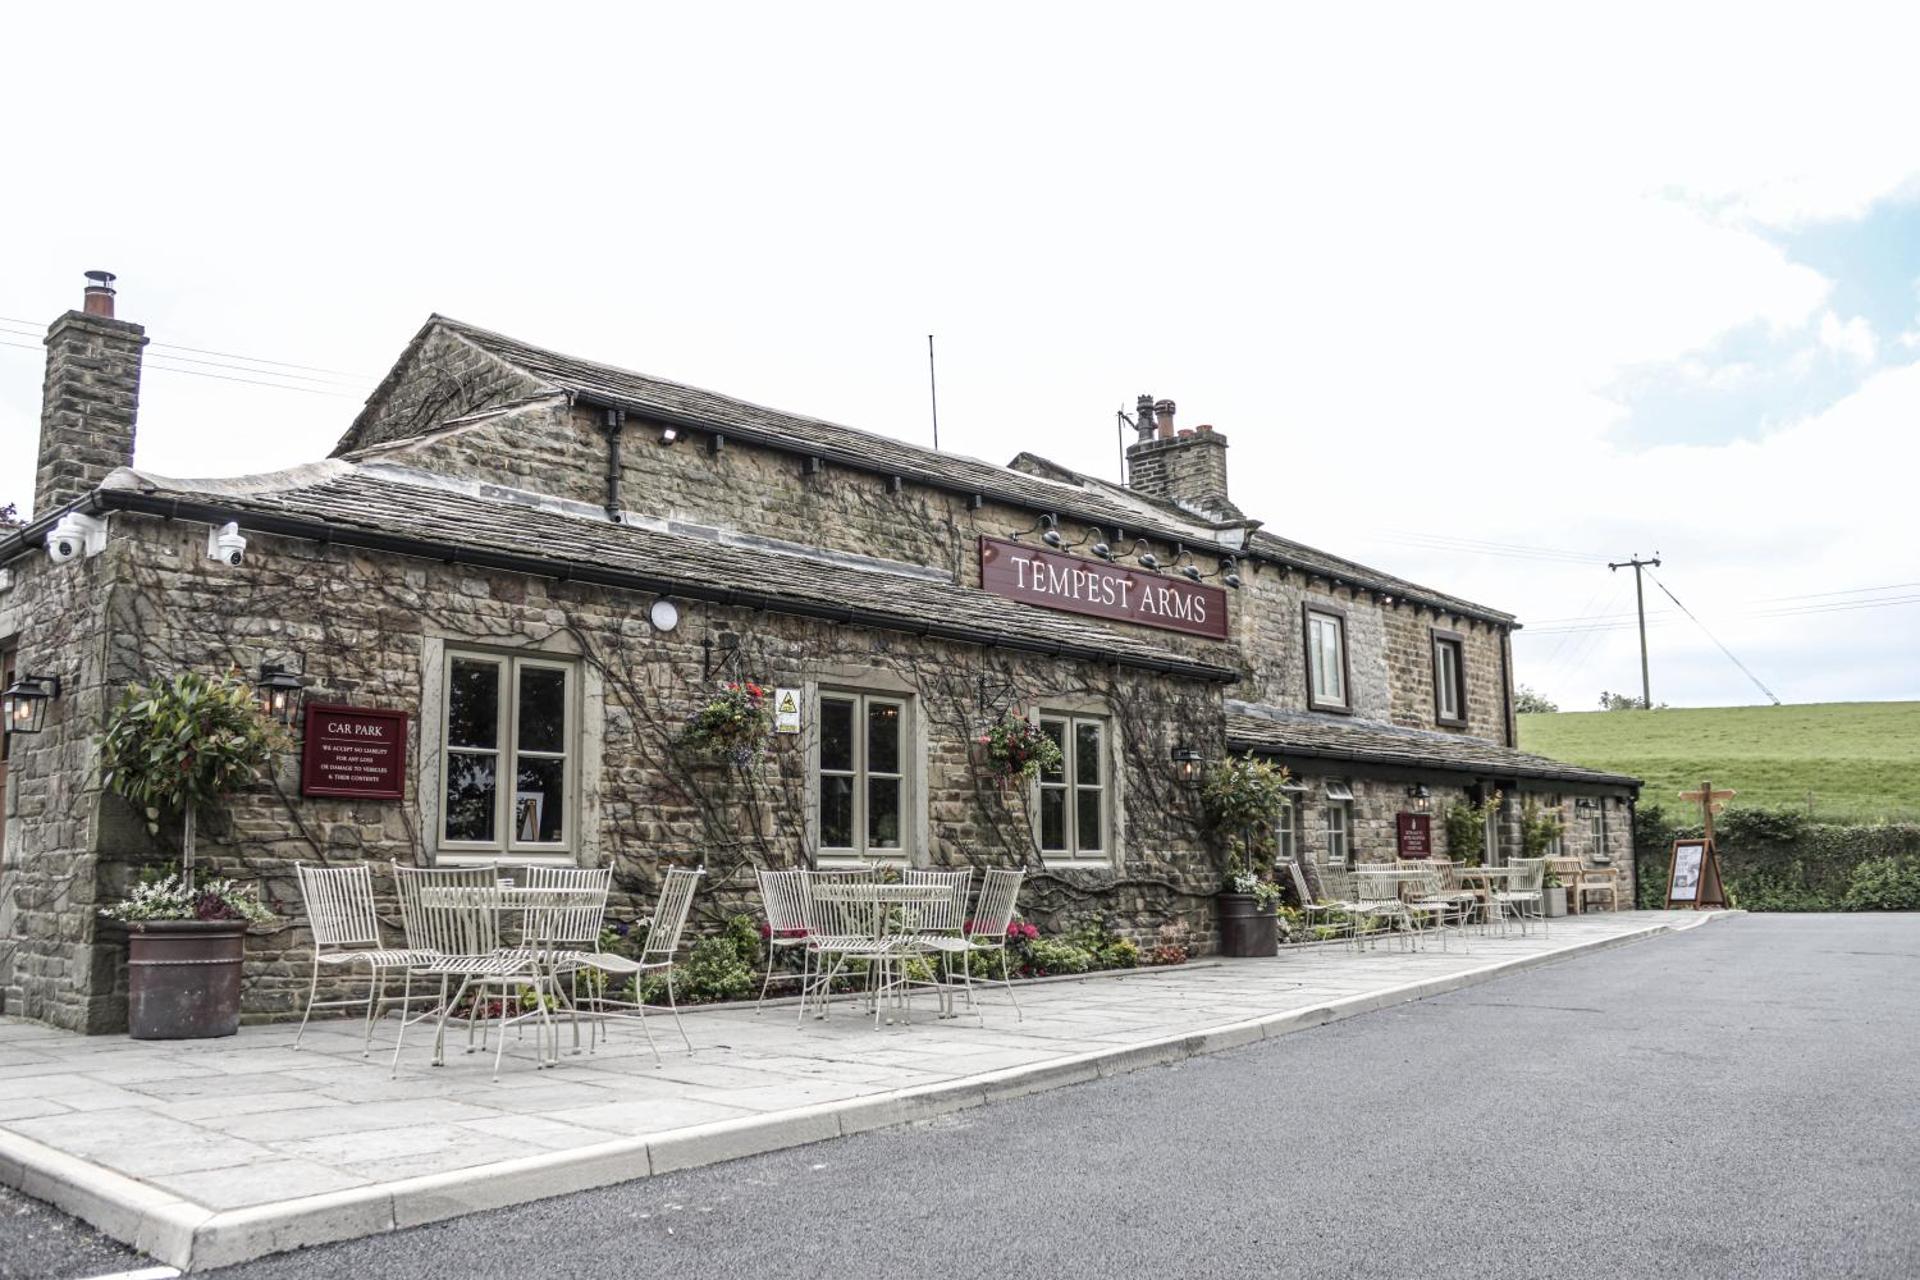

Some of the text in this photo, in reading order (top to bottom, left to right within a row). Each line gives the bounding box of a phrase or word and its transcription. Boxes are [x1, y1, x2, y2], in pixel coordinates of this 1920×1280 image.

[1011, 557, 1206, 623] TEMPEST ARMS
[328, 722, 382, 736] CAR PARK
